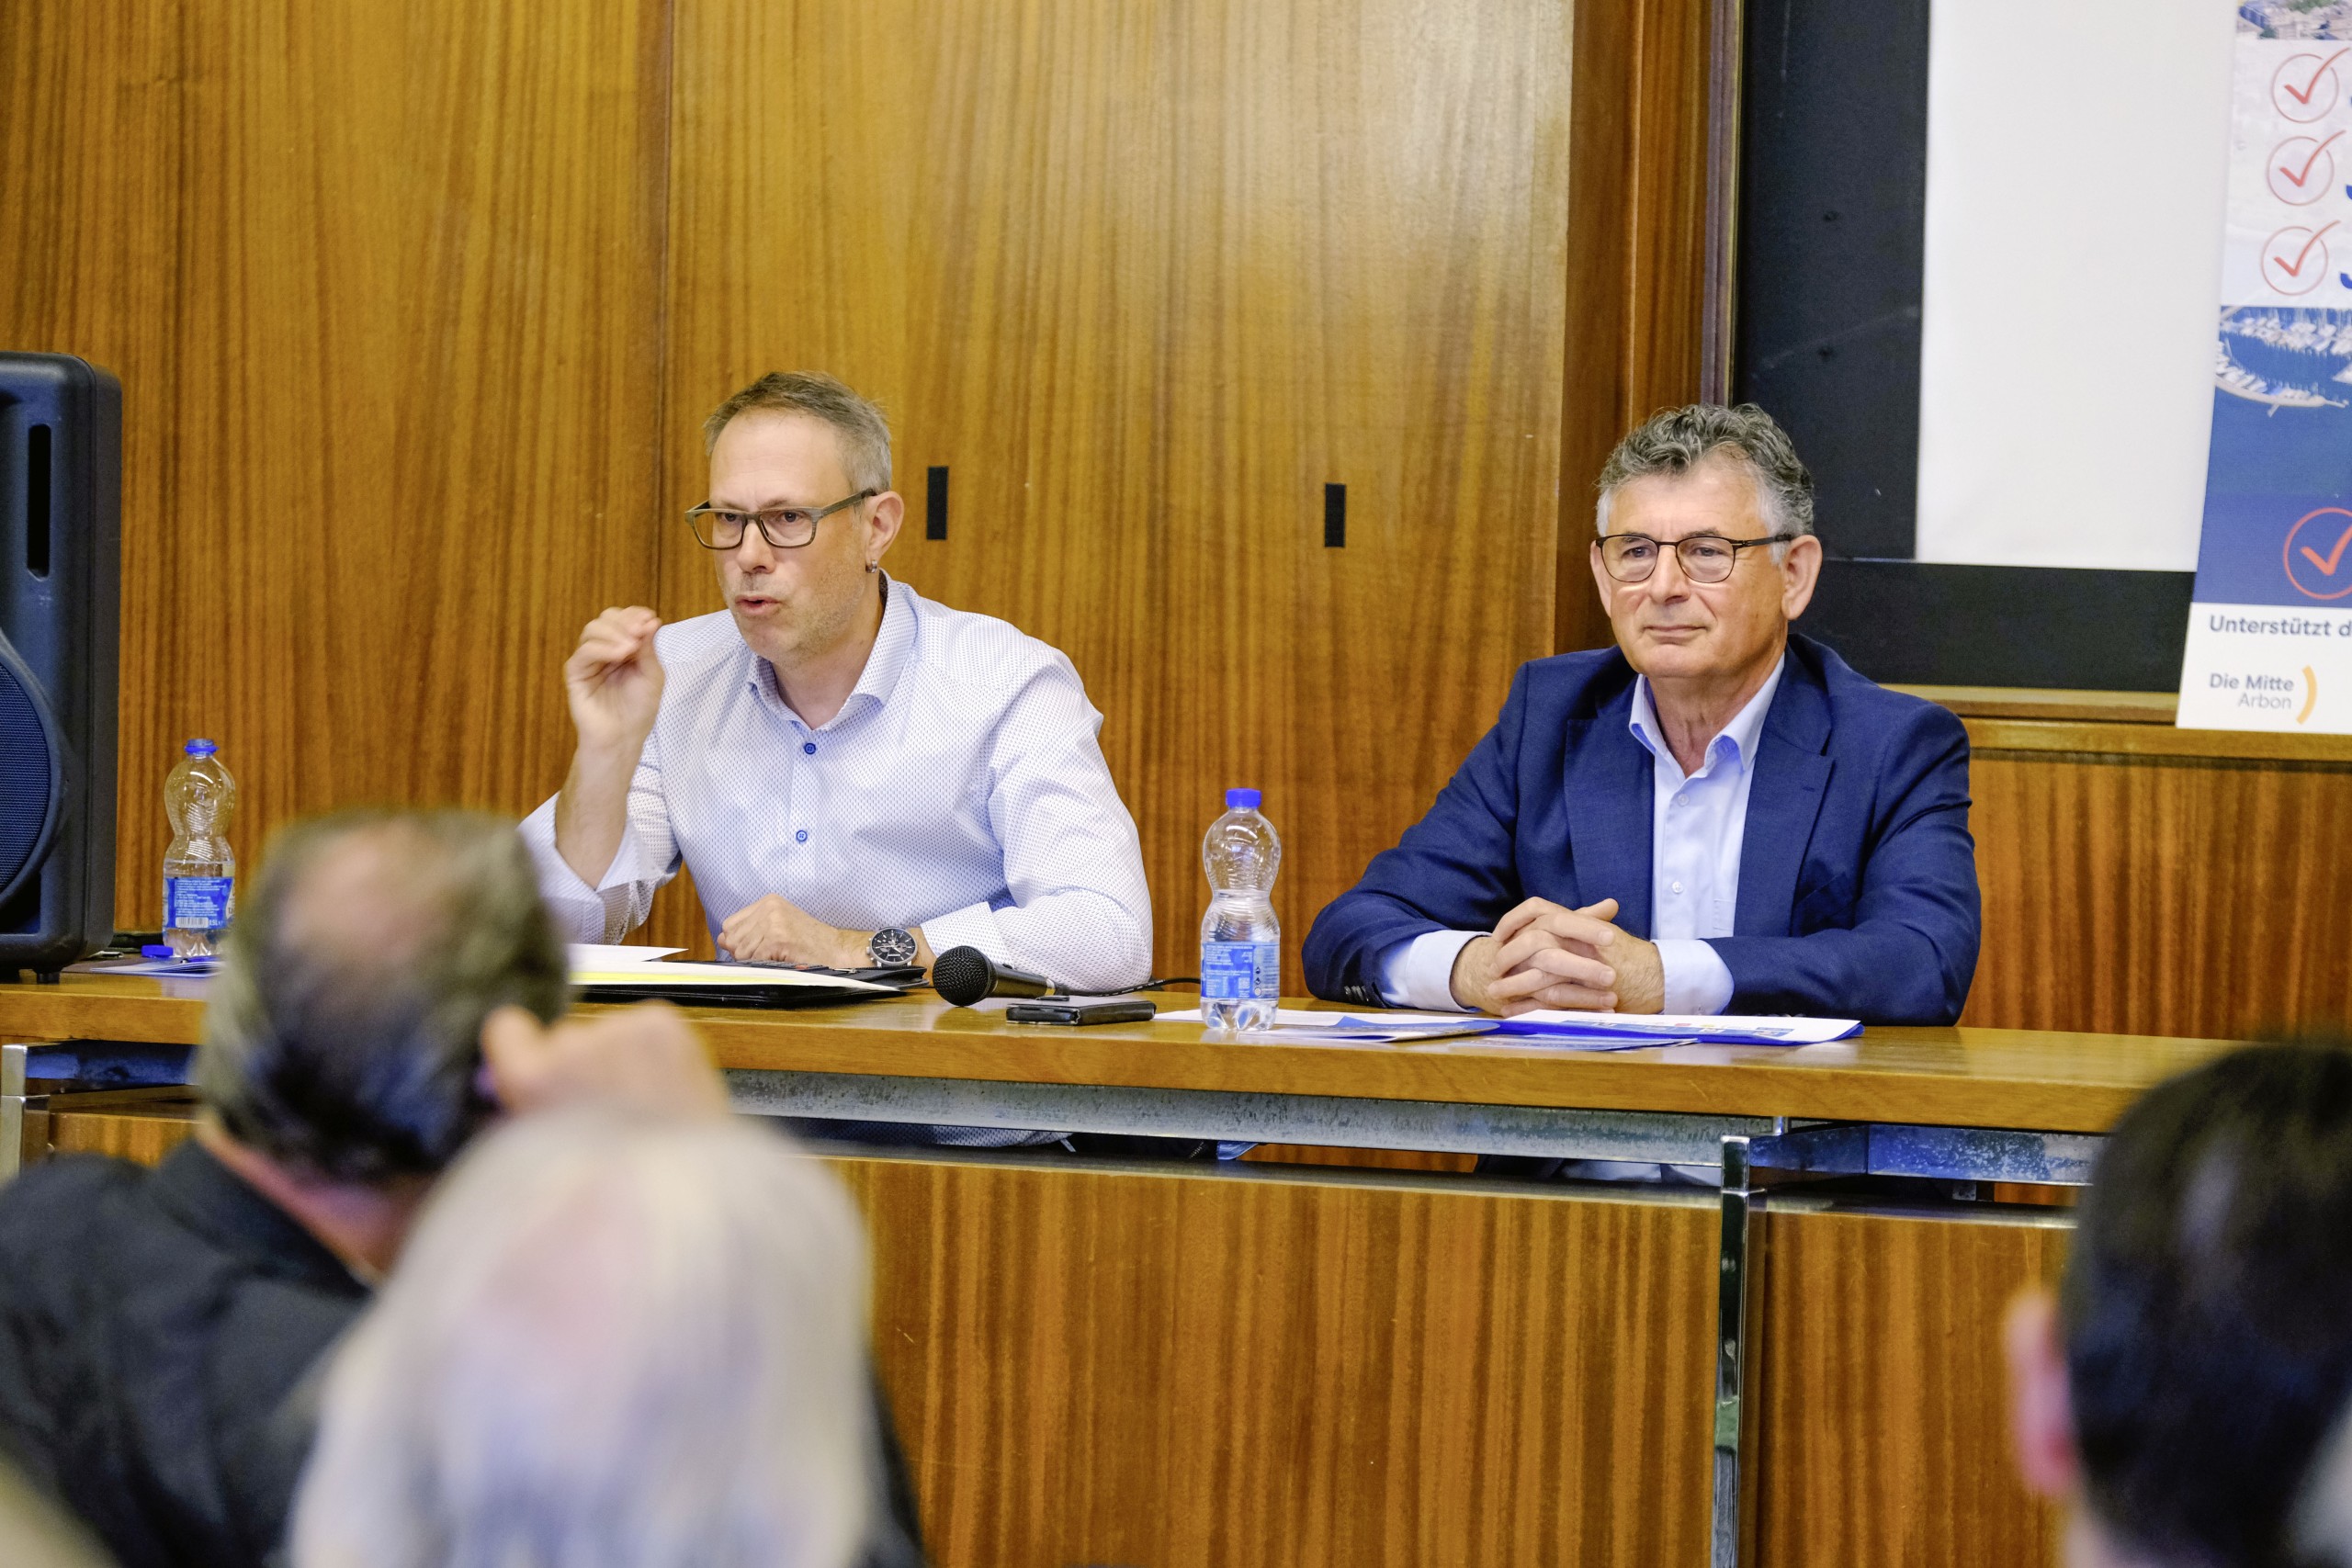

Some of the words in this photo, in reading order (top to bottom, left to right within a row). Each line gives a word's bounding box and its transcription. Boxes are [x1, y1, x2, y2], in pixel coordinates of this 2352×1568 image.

[2210, 615, 2332, 637] Unterstützt
[2210, 672, 2240, 689] Die
[2245, 674, 2294, 692] Mitte
[2238, 692, 2291, 709] Arbon
